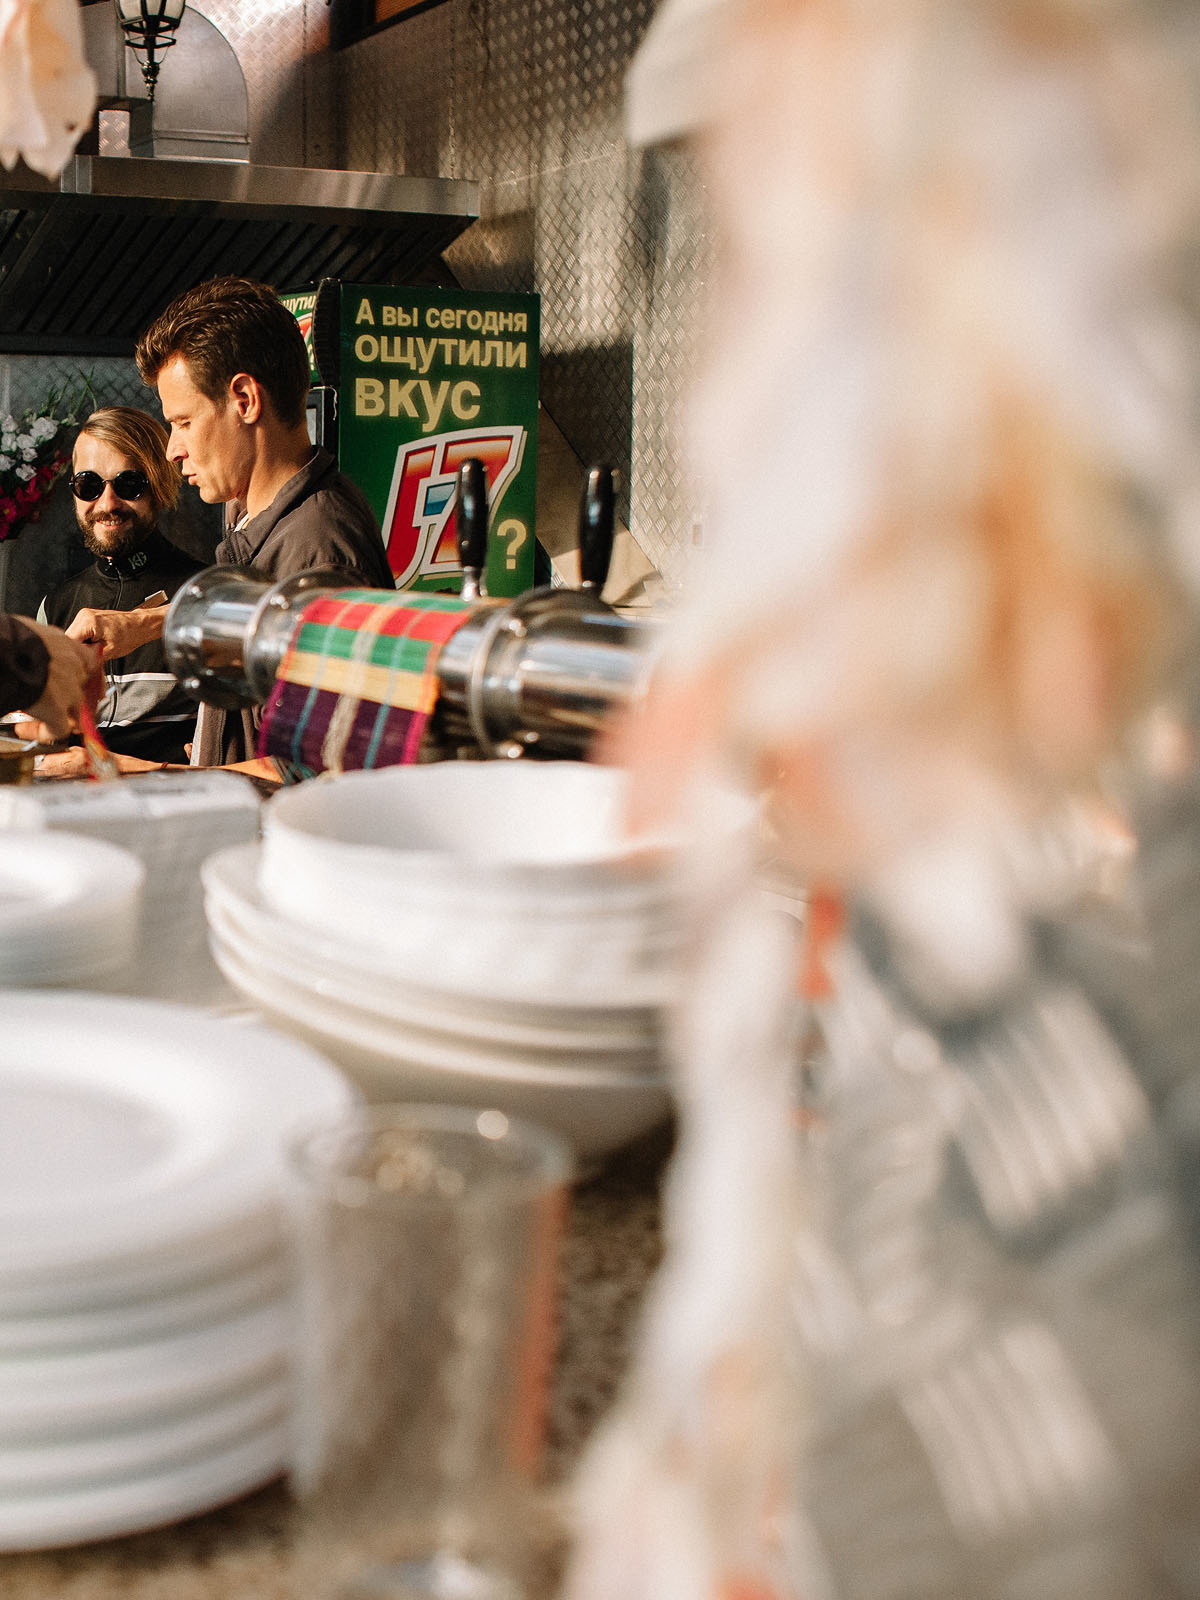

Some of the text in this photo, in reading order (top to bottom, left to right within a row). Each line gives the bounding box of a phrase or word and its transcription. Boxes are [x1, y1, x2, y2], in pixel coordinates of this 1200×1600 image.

[355, 298, 528, 336] А вы сегодня
[354, 334, 528, 374] ощутили
[355, 377, 481, 433] вкус
[497, 518, 527, 570] ?
